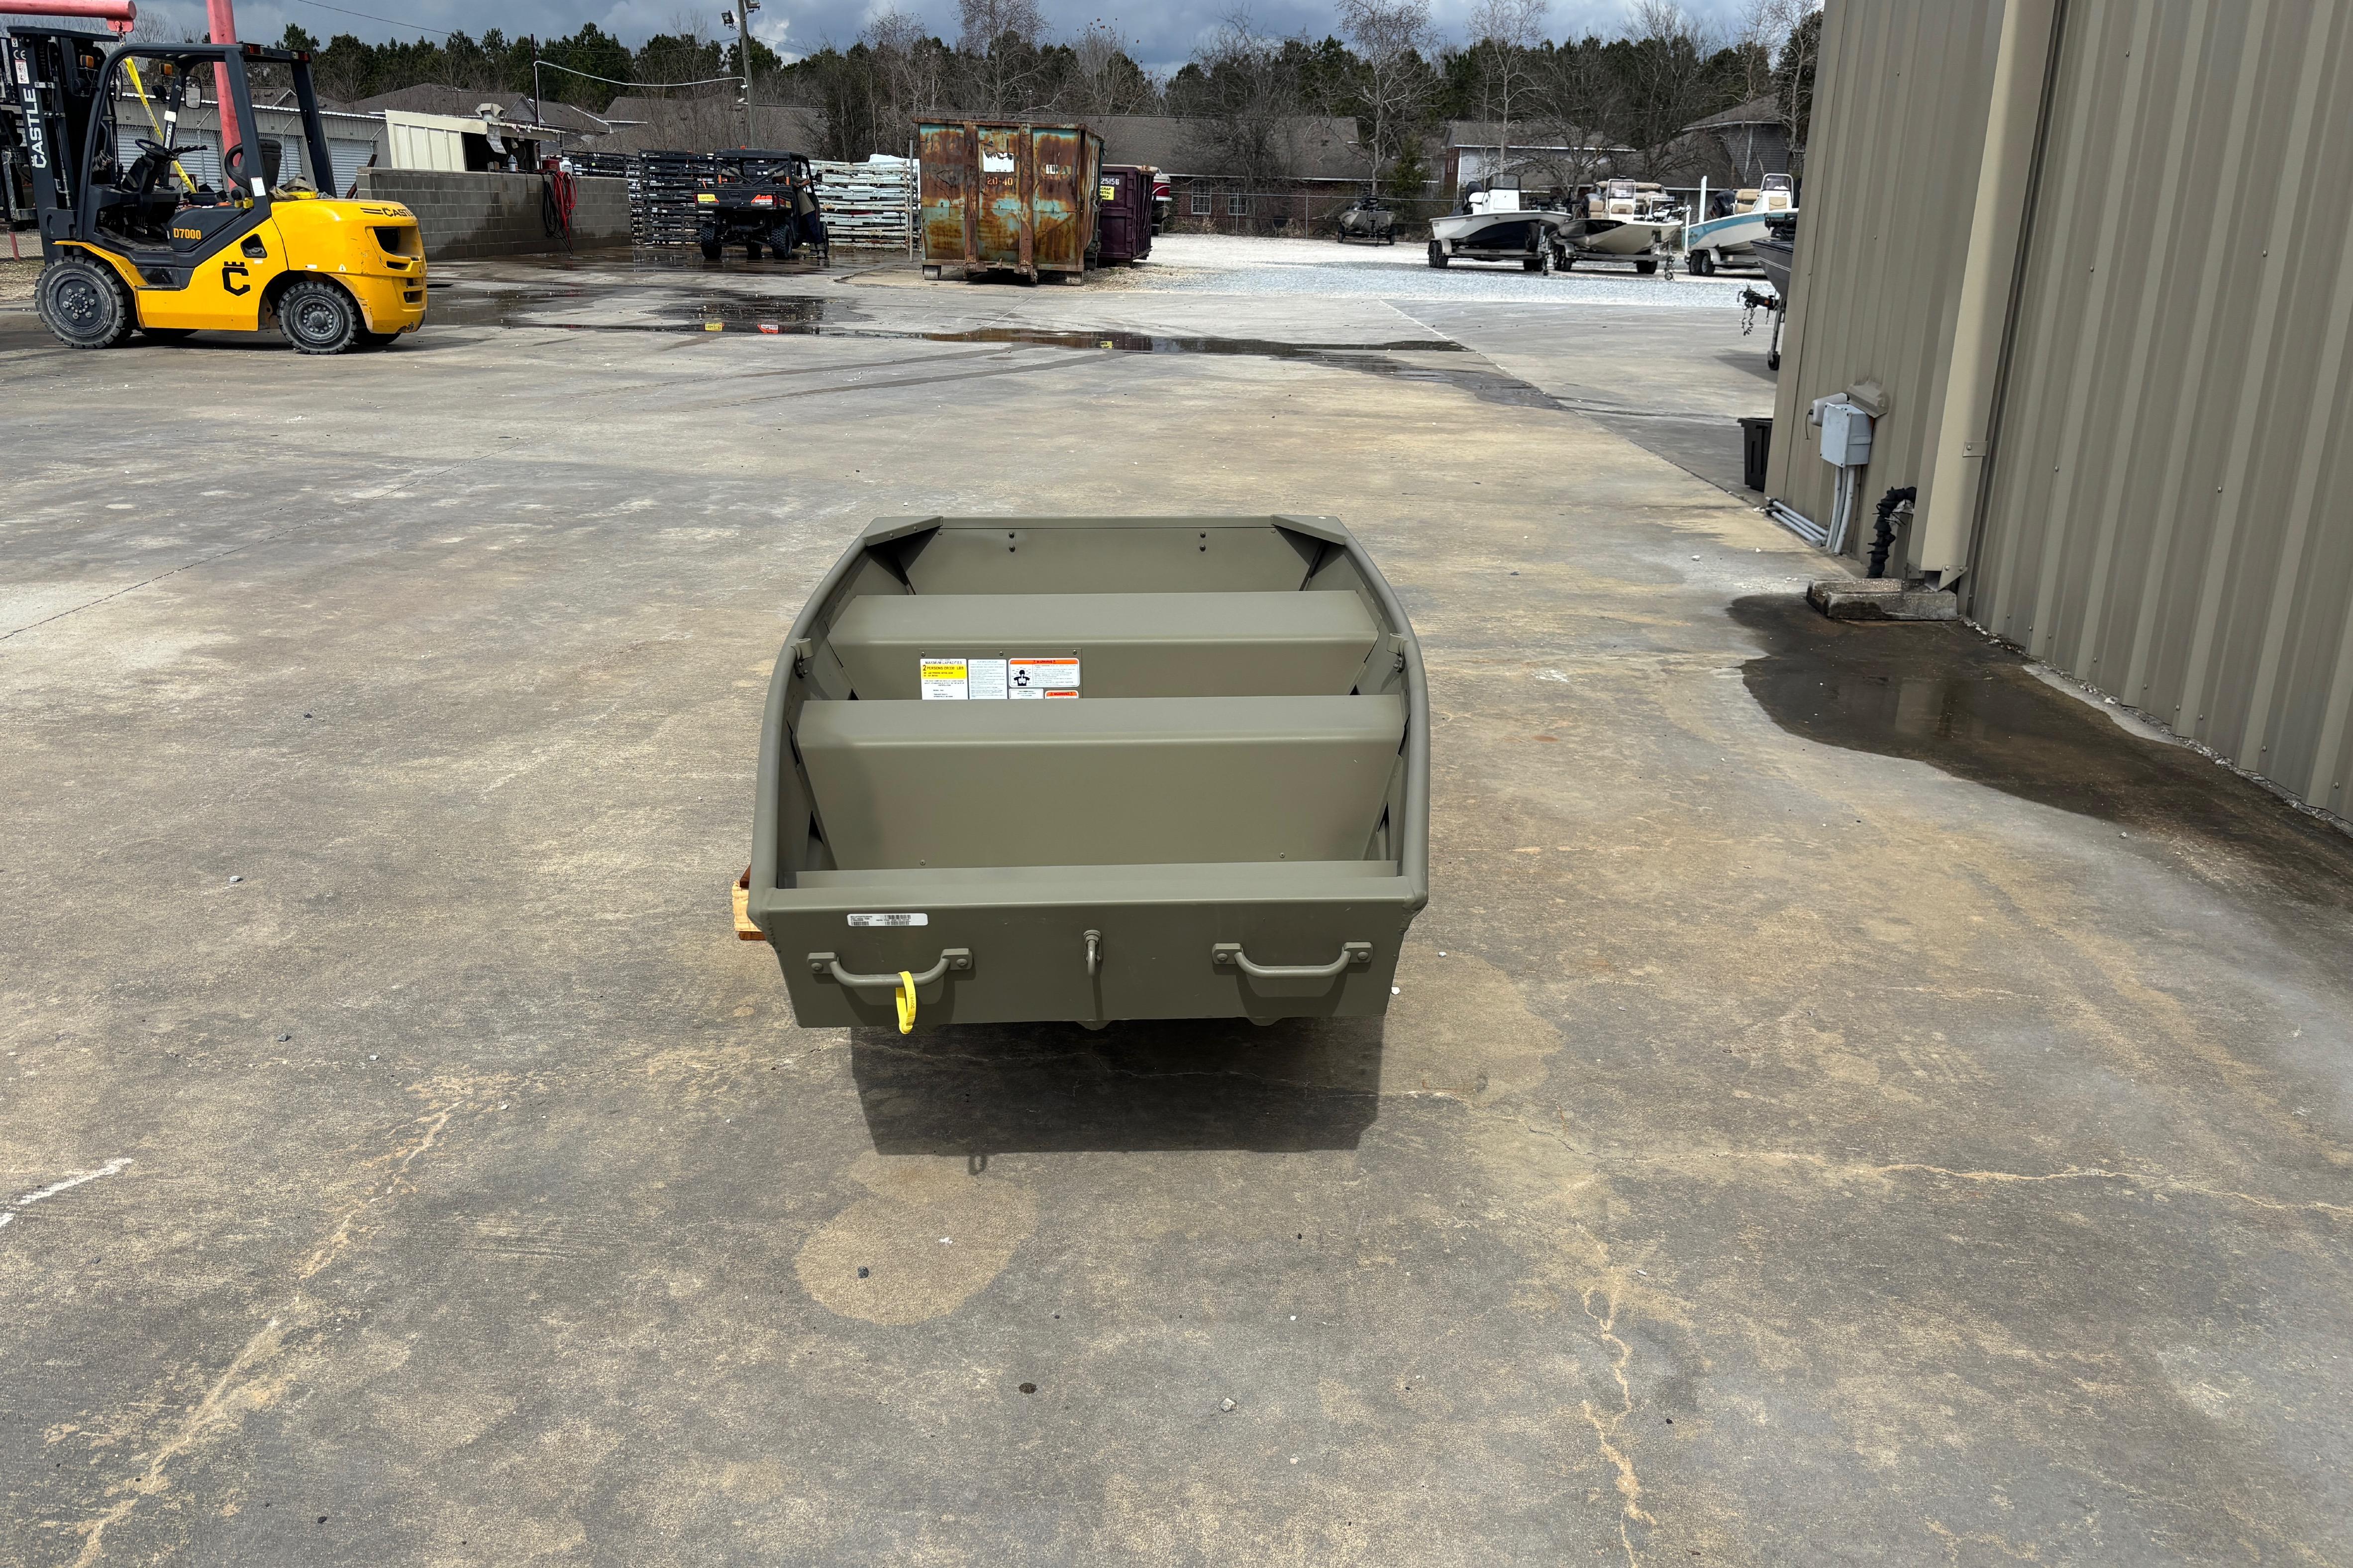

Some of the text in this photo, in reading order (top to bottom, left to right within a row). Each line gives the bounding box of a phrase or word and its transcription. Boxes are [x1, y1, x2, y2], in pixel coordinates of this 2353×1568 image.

[13, 49, 26, 60] CE
[23, 88, 47, 168] CASTLE
[382, 207, 413, 217] CASTL
[173, 228, 202, 240] D7000
